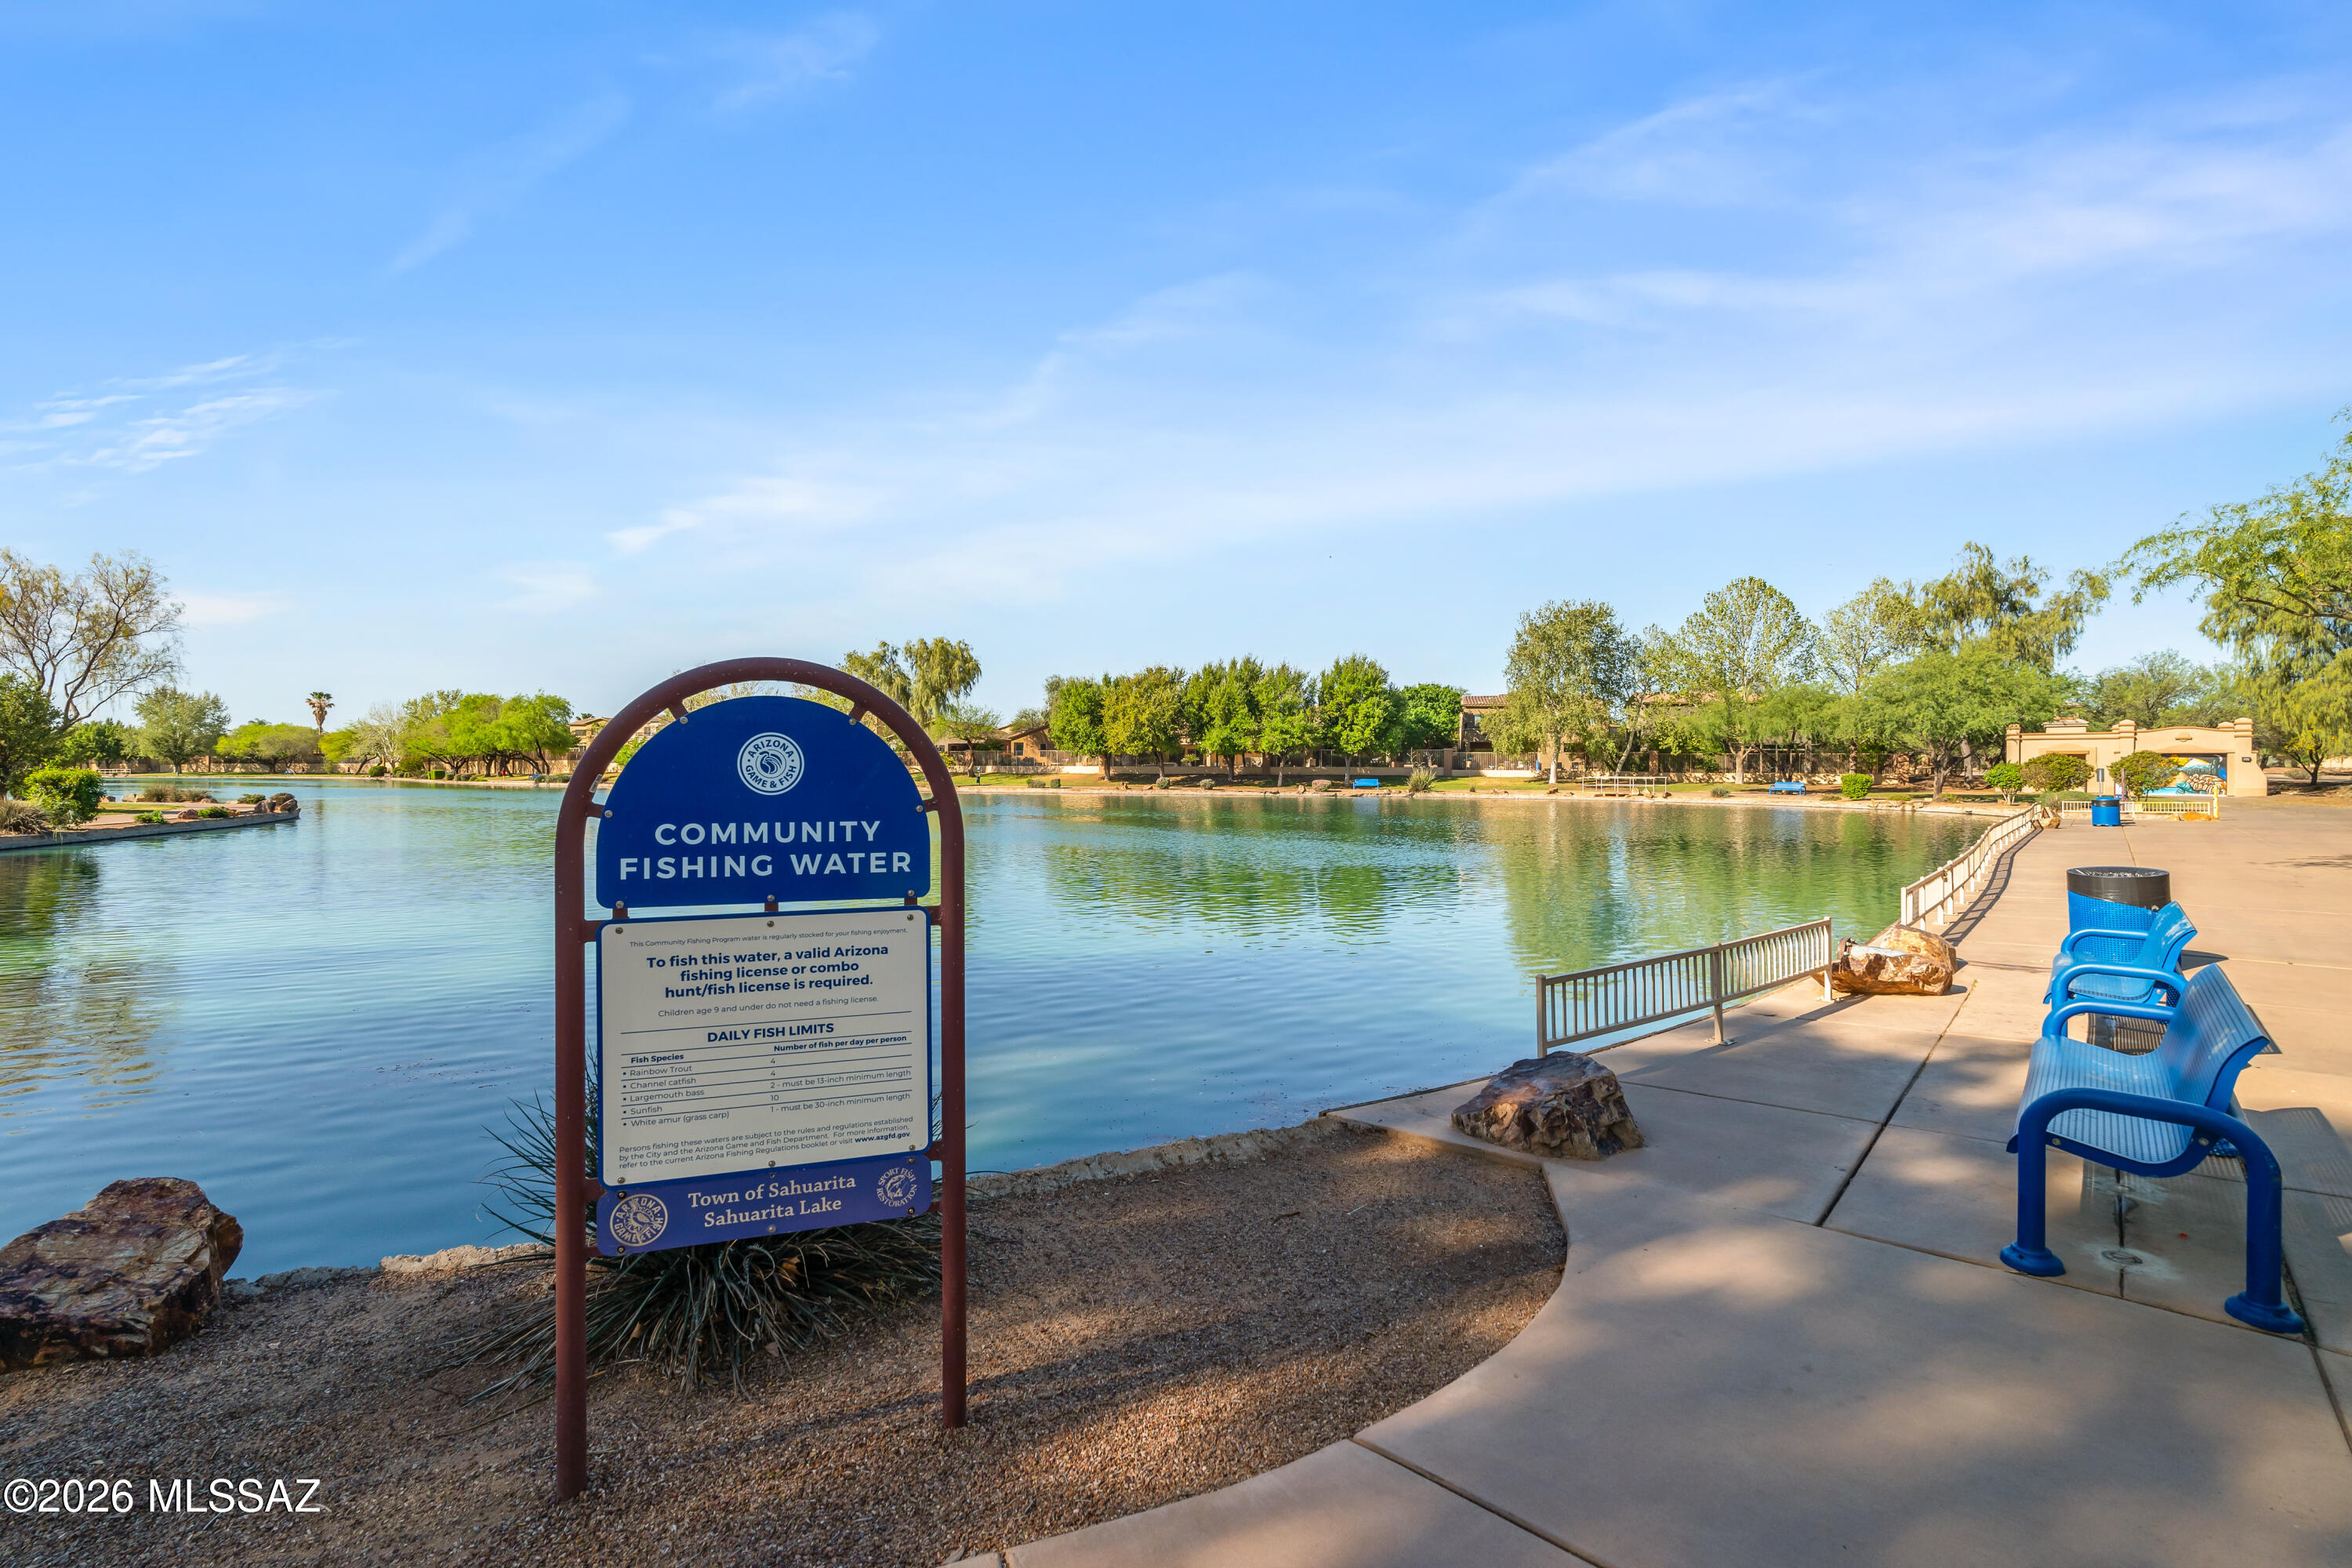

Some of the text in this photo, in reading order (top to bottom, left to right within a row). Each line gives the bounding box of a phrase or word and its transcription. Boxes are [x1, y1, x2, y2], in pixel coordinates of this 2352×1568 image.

[748, 739, 793, 757] ARIZONA
[746, 765, 768, 787] GAME
[779, 766, 797, 785] FISH
[654, 820, 880, 846] COMMUNITY
[619, 851, 911, 880] FISHING WATER
[647, 958, 666, 967] To
[670, 955, 697, 967] fish
[702, 953, 730, 964] this
[734, 952, 780, 963] water,
[796, 947, 830, 959] valid
[834, 946, 888, 957] Arizona
[681, 961, 858, 982] fishing license or combo
[665, 974, 873, 997] hunt/fish license is required.
[658, 1008, 694, 1017] Children
[707, 1023, 834, 1042] DAILY FISH LIMITS
[880, 1035, 907, 1044] person
[651, 1053, 684, 1063] Species
[630, 1068, 667, 1076] Rainbow
[887, 1069, 911, 1078] length
[630, 1077, 696, 1089] Channel catfish
[630, 1091, 683, 1102] Largemouth
[847, 1097, 884, 1105] minimum
[630, 1106, 662, 1115] Sunfish
[709, 1111, 729, 1120] carp)
[833, 1121, 872, 1131] regulations
[874, 1116, 913, 1126] established
[868, 1125, 909, 1134] information,
[756, 1144, 800, 1155] Regulations
[855, 1131, 910, 1143] www.azgfd.gov
[878, 1167, 916, 1185] SPORT FISH
[688, 1176, 856, 1207] Town of Sahuarita
[877, 1184, 917, 1207] RESTORATION
[615, 1198, 661, 1218] ARZONA
[704, 1196, 842, 1227] Sahuarita Lake
[615, 1223, 637, 1242] GAME
